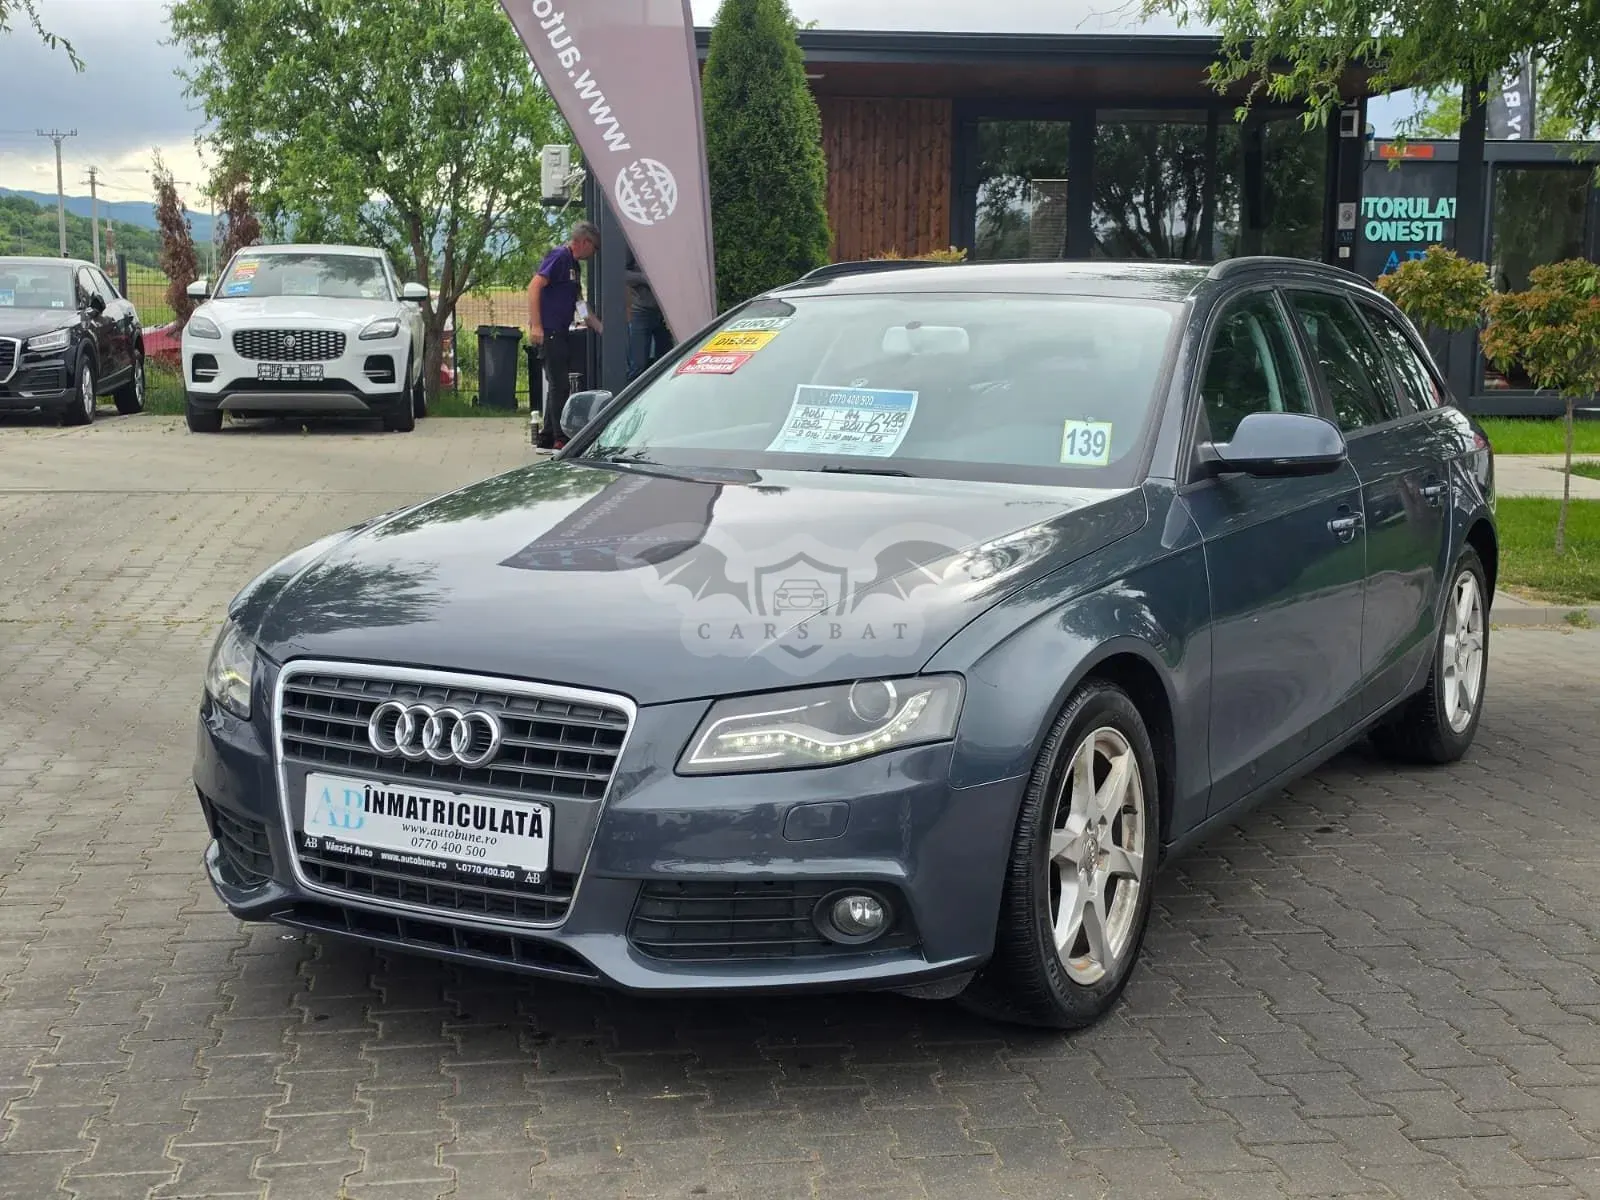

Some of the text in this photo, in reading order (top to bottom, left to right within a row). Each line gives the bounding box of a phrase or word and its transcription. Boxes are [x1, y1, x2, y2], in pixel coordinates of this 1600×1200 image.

[1361, 197, 1457, 219] TORULAT
[1365, 221, 1443, 242] ONESTI
[715, 337, 759, 346] DIESEL
[1067, 428, 1106, 457] 139
[363, 784, 543, 839] ÎNMATRICULATĂ
[401, 822, 498, 845] www.autobune.ro
[411, 836, 486, 857] 0770 400 500
[304, 837, 318, 848] AB
[354, 846, 373, 857] Auto
[381, 852, 447, 869] www.autobune.ro
[462, 863, 515, 879] 0770.400.500
[524, 872, 541, 884] AB
